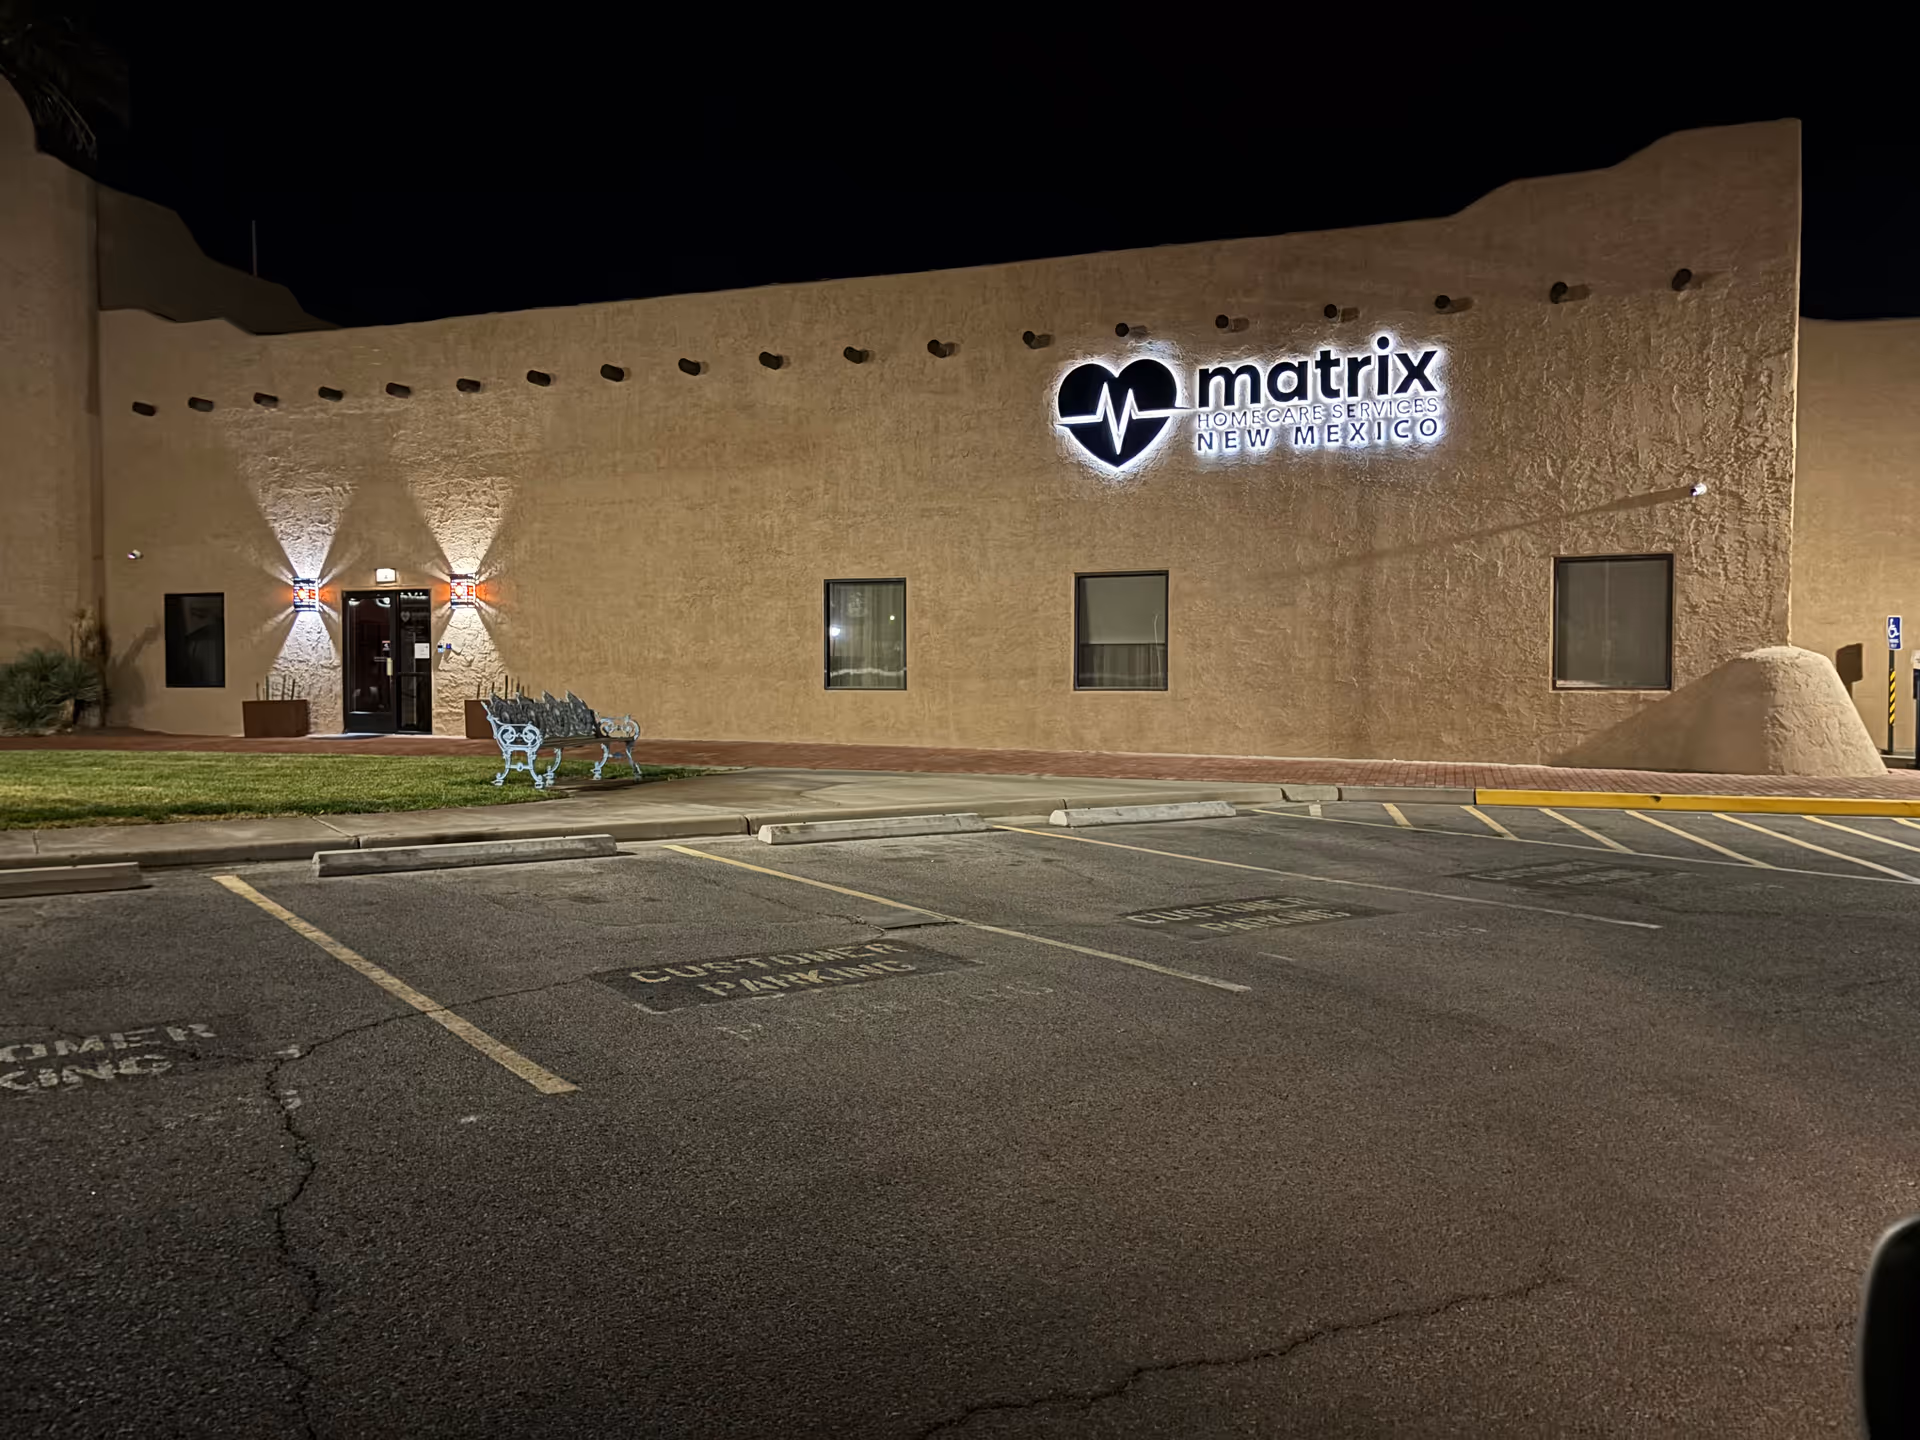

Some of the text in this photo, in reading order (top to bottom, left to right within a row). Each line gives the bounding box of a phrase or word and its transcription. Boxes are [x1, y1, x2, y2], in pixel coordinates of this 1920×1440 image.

[1198, 336, 1437, 408] matrix
[1332, 398, 1438, 419] SERVICES
[1197, 417, 1438, 451] NEW MEXICO
[630, 942, 908, 983] CUSTOMER
[697, 960, 916, 997] PARKING
